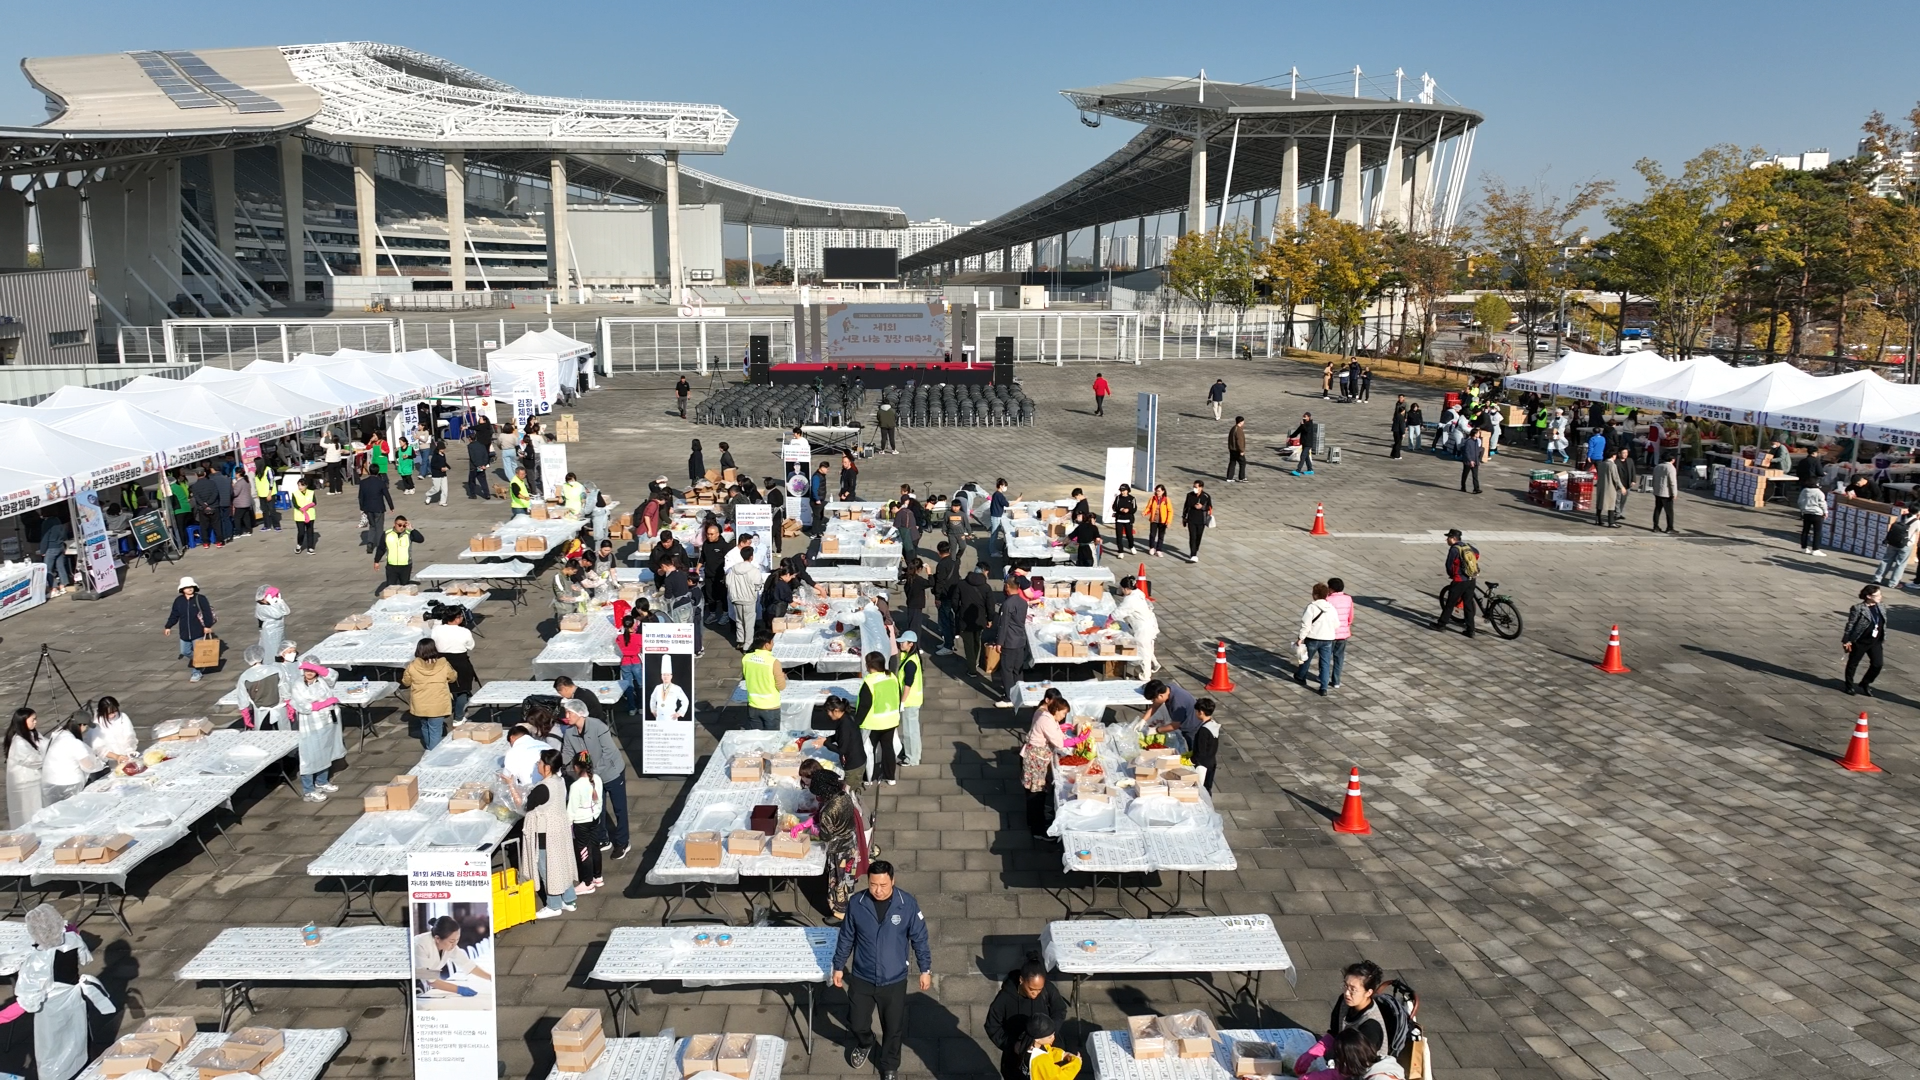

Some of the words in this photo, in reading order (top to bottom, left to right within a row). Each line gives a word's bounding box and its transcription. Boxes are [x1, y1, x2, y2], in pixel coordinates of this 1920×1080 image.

[872, 323, 896, 331] 제1회
[842, 334, 860, 343] 서로
[904, 334, 932, 343] 대축제
[1707, 409, 1731, 420] 청라1동
[1791, 422, 1820, 433] 청라2동
[92, 466, 141, 489] 분구추진실무준비단
